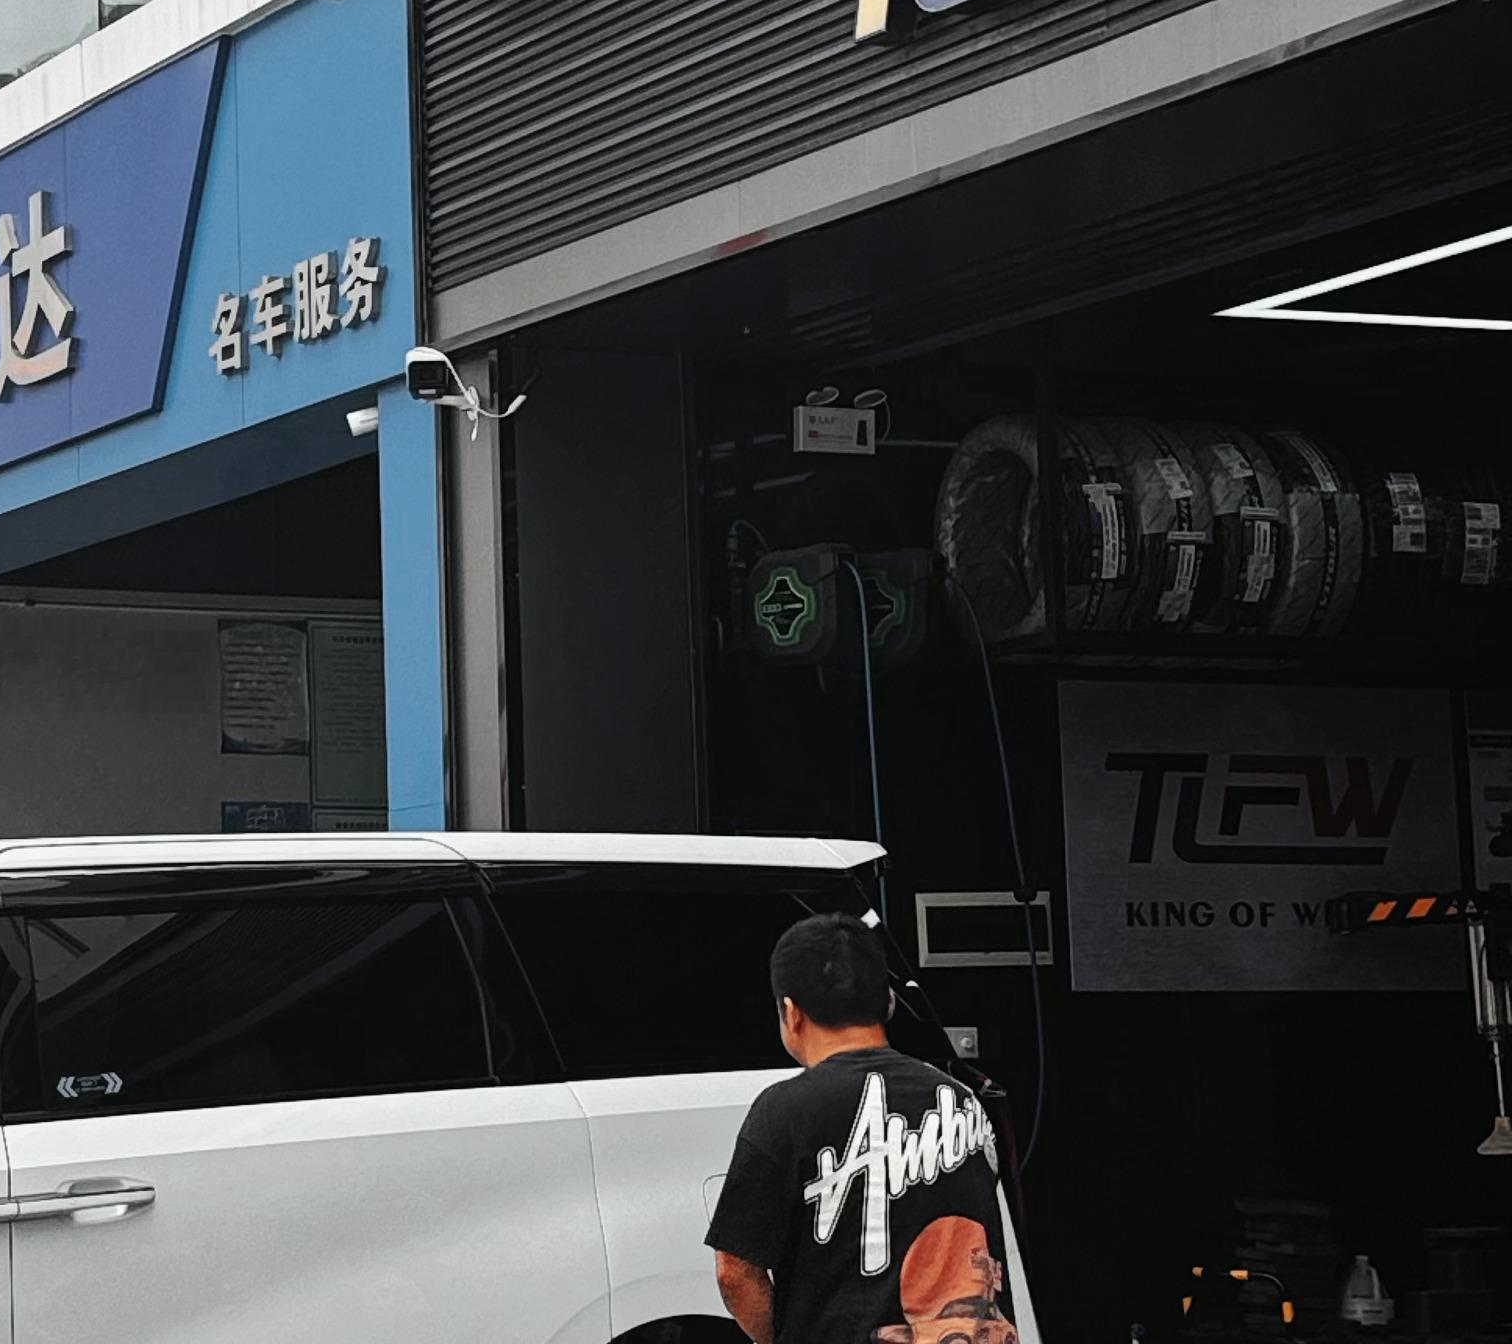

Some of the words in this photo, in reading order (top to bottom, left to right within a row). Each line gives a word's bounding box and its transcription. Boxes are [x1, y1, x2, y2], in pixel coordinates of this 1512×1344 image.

[208, 236, 388, 377] 名车服务
[1125, 900, 1215, 929] KING
[1228, 900, 1277, 929] OF
